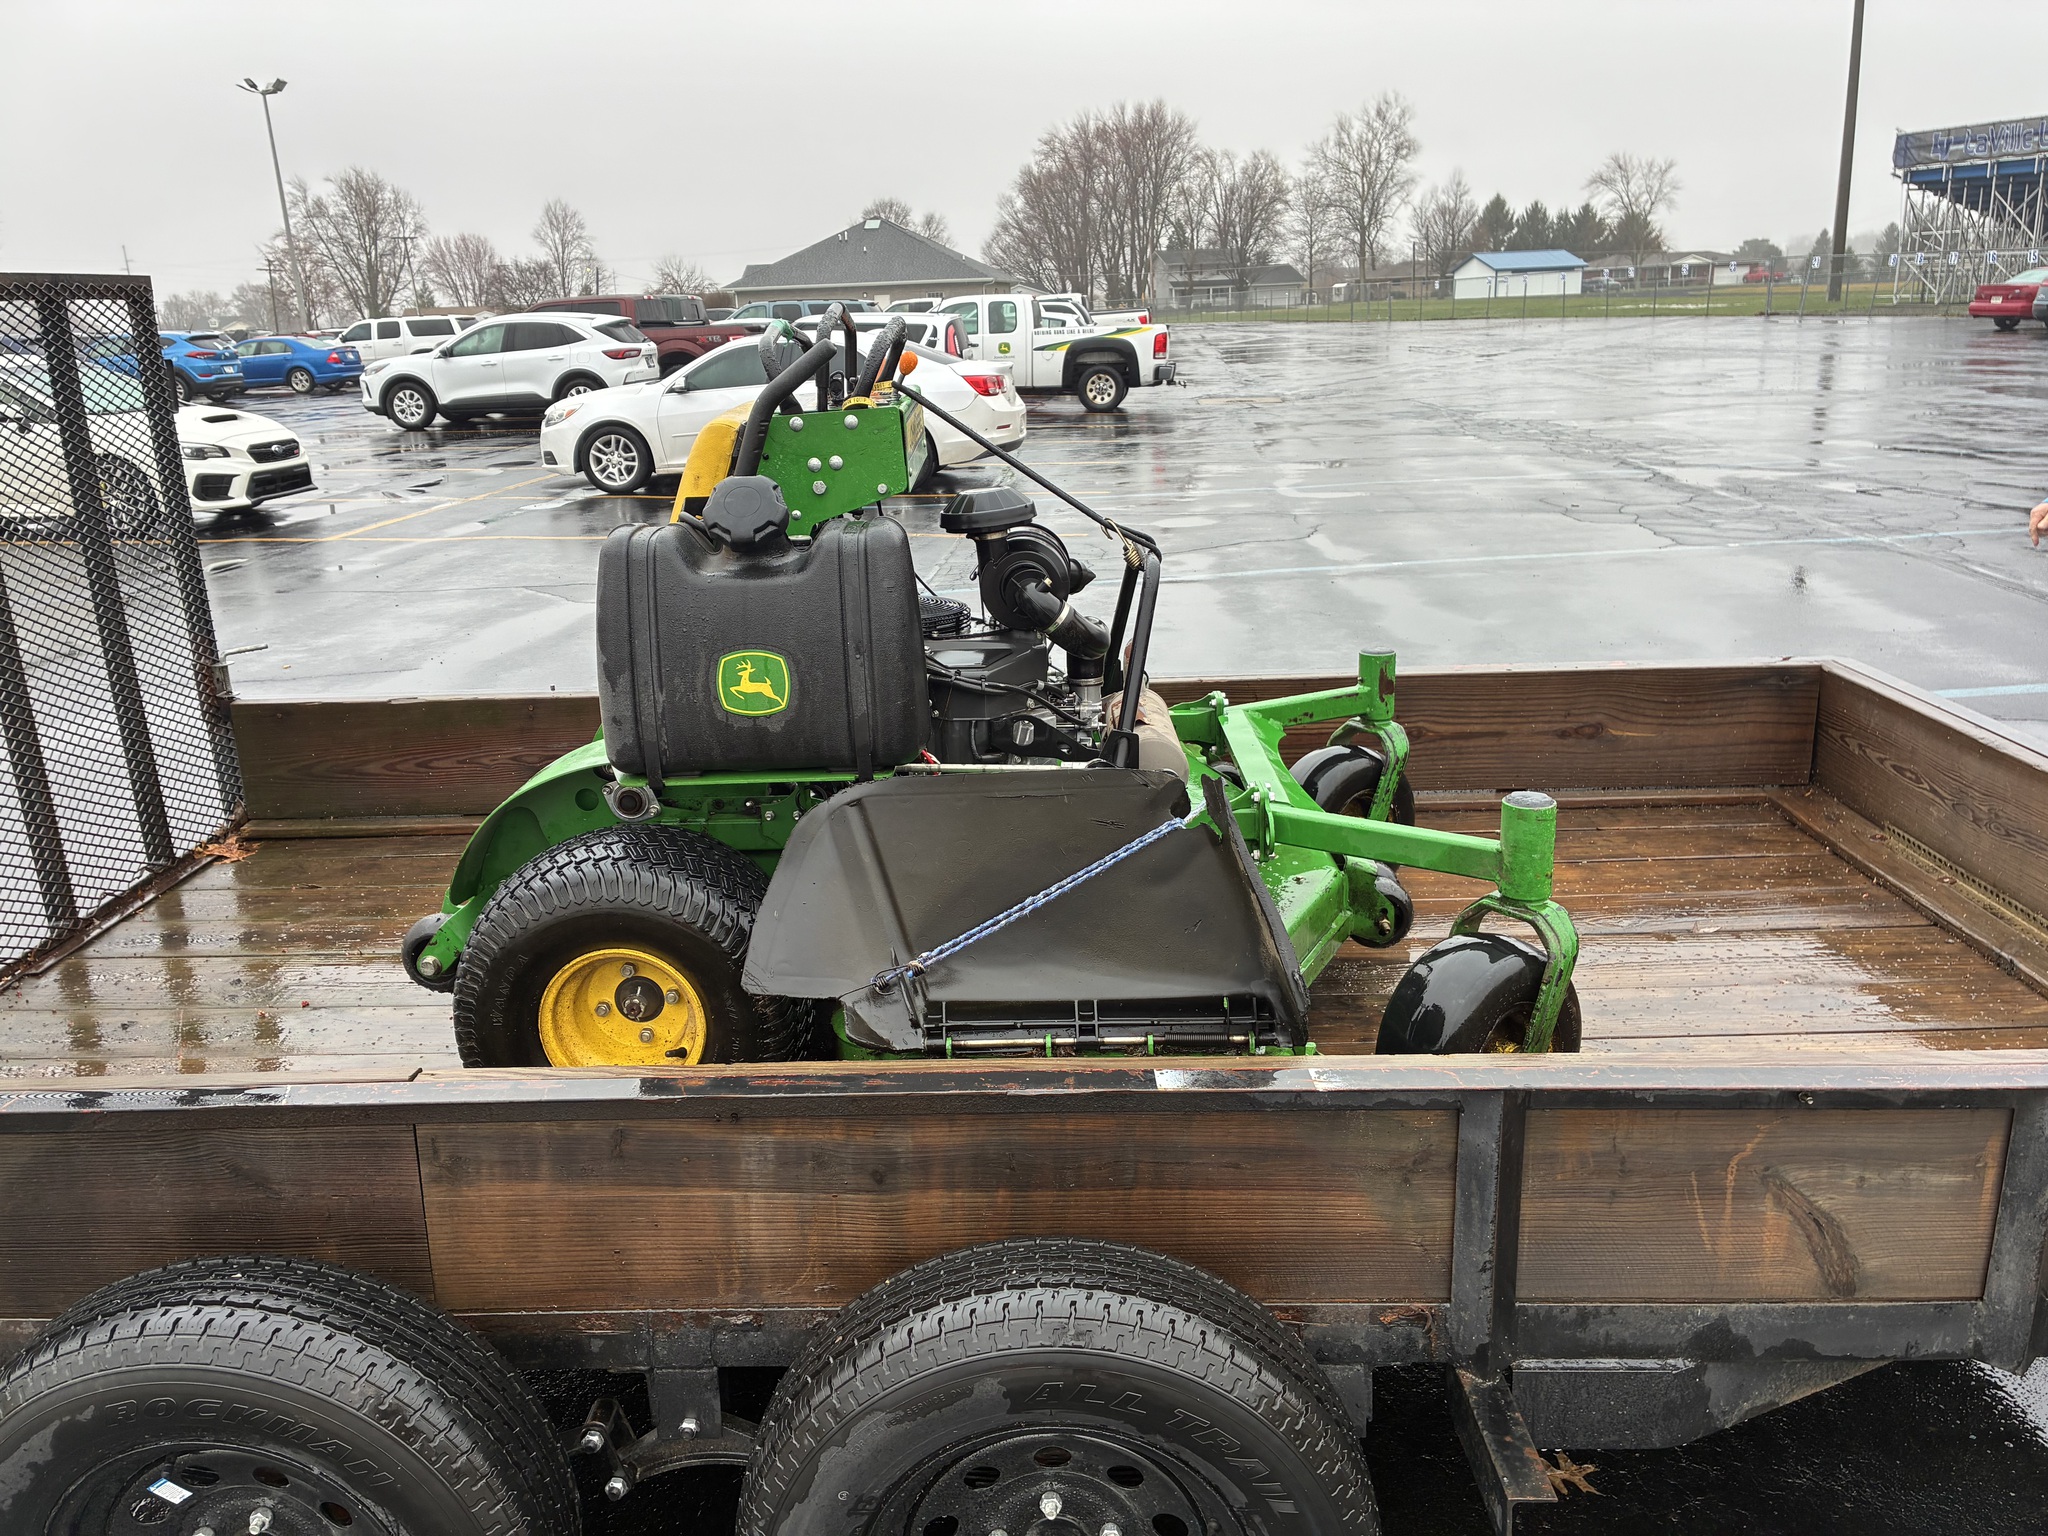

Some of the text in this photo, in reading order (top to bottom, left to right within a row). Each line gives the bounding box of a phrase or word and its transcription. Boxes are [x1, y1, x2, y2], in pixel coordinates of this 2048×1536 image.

[1963, 123, 2034, 156] LaVille
[489, 954, 529, 1027] WANDA
[906, 1393, 947, 1417] SERVICE
[950, 1384, 974, 1399] ONLY
[104, 1396, 396, 1487] ROCKMAN
[1024, 1381, 1300, 1516] ALL TRAIL
